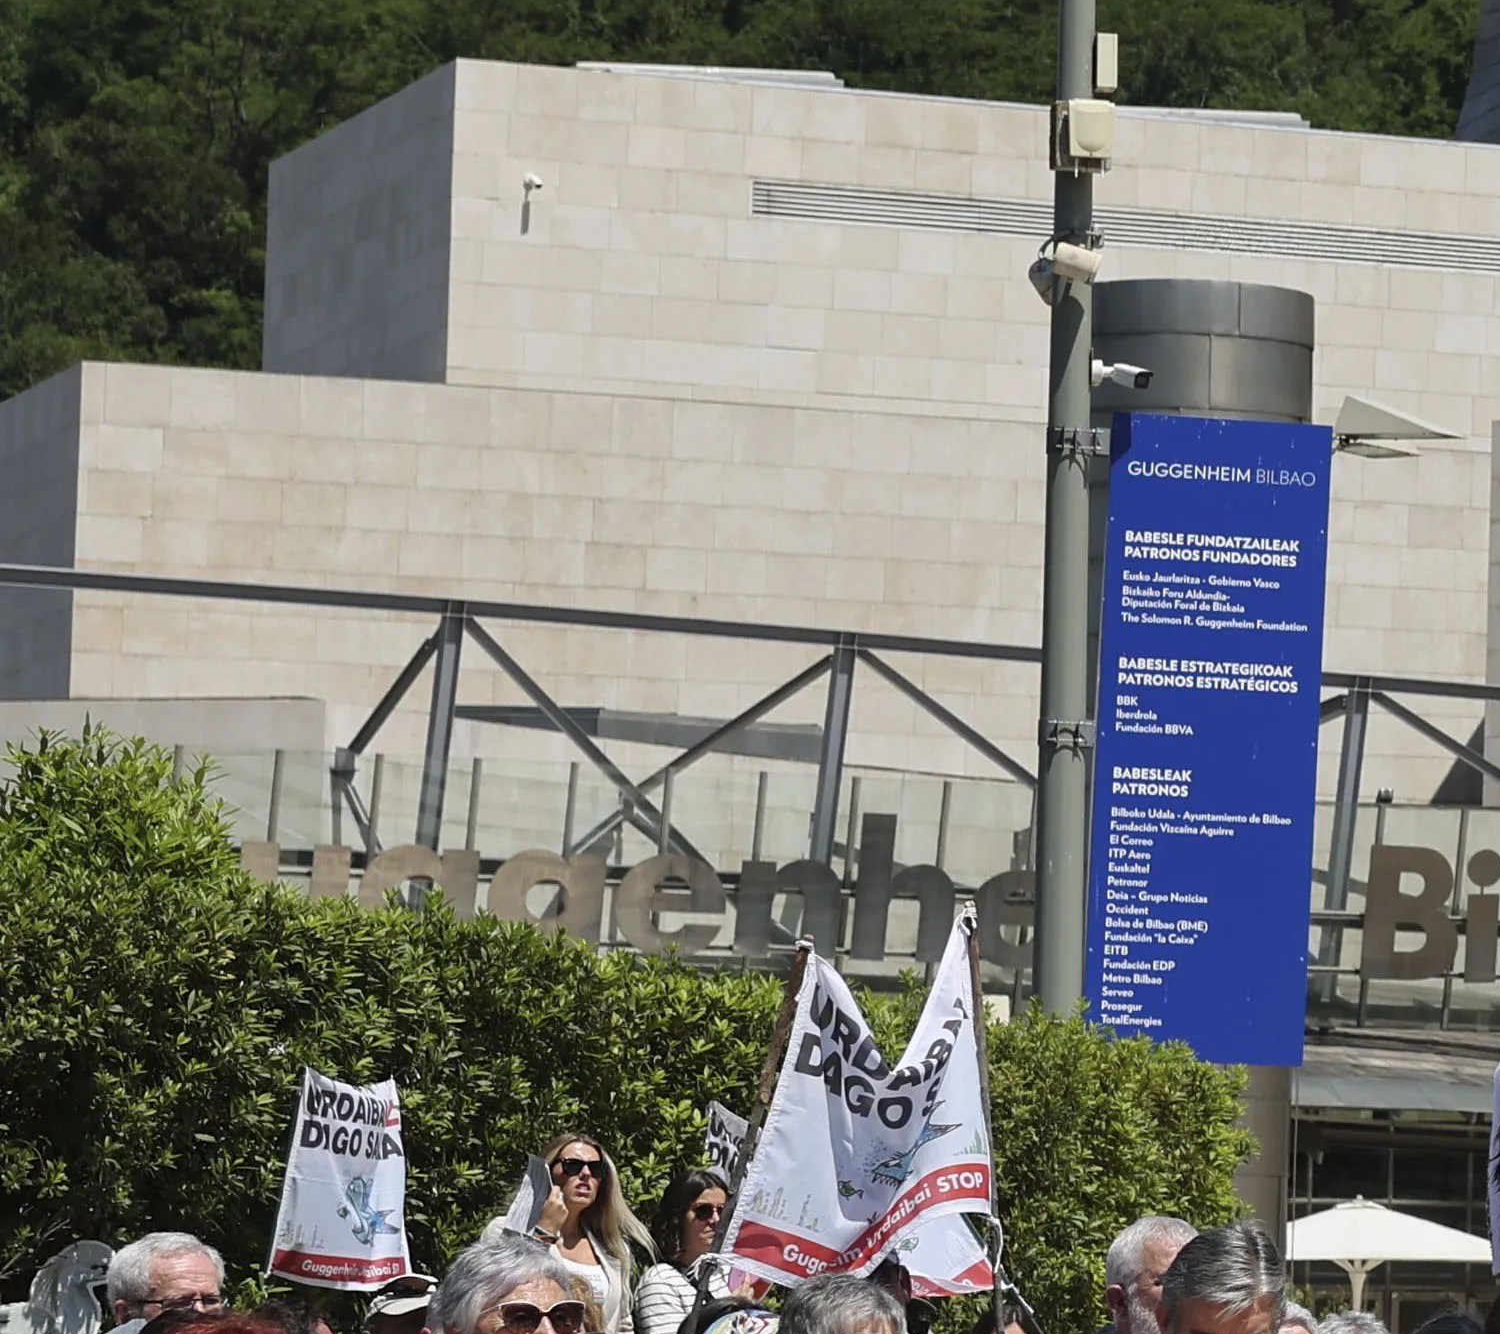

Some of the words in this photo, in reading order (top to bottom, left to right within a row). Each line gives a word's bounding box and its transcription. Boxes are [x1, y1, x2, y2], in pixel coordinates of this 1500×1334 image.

[1127, 461, 1251, 483] GUGGENHEIM
[1256, 469, 1316, 487] BILBAO
[1125, 530, 1184, 546] BABESLE
[1187, 534, 1300, 553] FUNDATZAILEAK
[1124, 546, 1200, 562] PATRONOS
[1202, 551, 1297, 567] FUNDADORES
[1123, 570, 1150, 582] Eusko
[1152, 571, 1200, 584] Jaurlaritza
[1208, 575, 1251, 588] Gobierno
[1253, 579, 1280, 589] Vasco
[1122, 586, 1160, 598] Bizkaiko
[1162, 588, 1184, 599] Foru
[1121, 598, 1172, 611] Diputación
[1174, 600, 1197, 611] Foral
[1199, 601, 1211, 611] de
[1213, 602, 1245, 613] Bizkaia
[1121, 612, 1139, 623] The
[1141, 613, 1182, 625] Solomon
[1183, 616, 1193, 626] R.
[1195, 617, 1254, 630] Guggenheim
[1256, 620, 1308, 632] Foundation
[1119, 656, 1178, 672] BABESLE
[1181, 660, 1293, 678] ESTRATEGIKOAK
[1118, 672, 1194, 688] PATRONOS
[1196, 675, 1298, 693] ESTRATÉGICOS
[1116, 695, 1138, 706] BBK
[1116, 708, 1157, 720] Iberdrola
[1115, 722, 1163, 734] Fundación
[1165, 724, 1193, 735] BBVA
[1113, 766, 1192, 782] BABESLEAK
[1112, 782, 1188, 797] PATRONOS
[1111, 807, 1146, 818] Bilboko
[1148, 808, 1175, 820] Udala
[1183, 811, 1247, 824] Ayuntamiento
[1249, 813, 1261, 824] de
[1262, 814, 1291, 825] Bilbao
[1110, 821, 1158, 833] Fundación
[1160, 822, 1198, 834] Vizcaína
[1200, 825, 1234, 838] Aguirre
[1110, 835, 1119, 845] El
[1121, 835, 1153, 846] Correo
[1109, 848, 1127, 859] ITP
[1128, 849, 1151, 860] Aero
[1108, 862, 1150, 874] Euskaltel
[1107, 876, 1148, 888] Petronor
[1107, 890, 1129, 901] Deia
[1138, 891, 1168, 904] Grupo
[1170, 893, 1208, 904] Noticias
[1106, 903, 1149, 915] Occident
[1105, 917, 1130, 929] Bolsa
[1132, 918, 1144, 929] de
[1146, 919, 1175, 930] Bilbao
[1177, 920, 1208, 933] (BME)
[1104, 931, 1152, 943] Fundación
[1104, 945, 1128, 956] EITB
[1103, 958, 1151, 971] Fundación
[1152, 960, 1175, 971] EDP
[1102, 972, 1131, 984] Metro
[1133, 973, 1162, 985] Bilbao
[1101, 986, 1134, 998] Serveo
[1101, 1000, 1142, 1013] Prosegur
[1101, 1014, 1162, 1027] TotalEnergies
[794, 1032, 913, 1130] DAGO
[866, 1183, 933, 1250] Urdaibai
[936, 1171, 984, 1193] STOP
